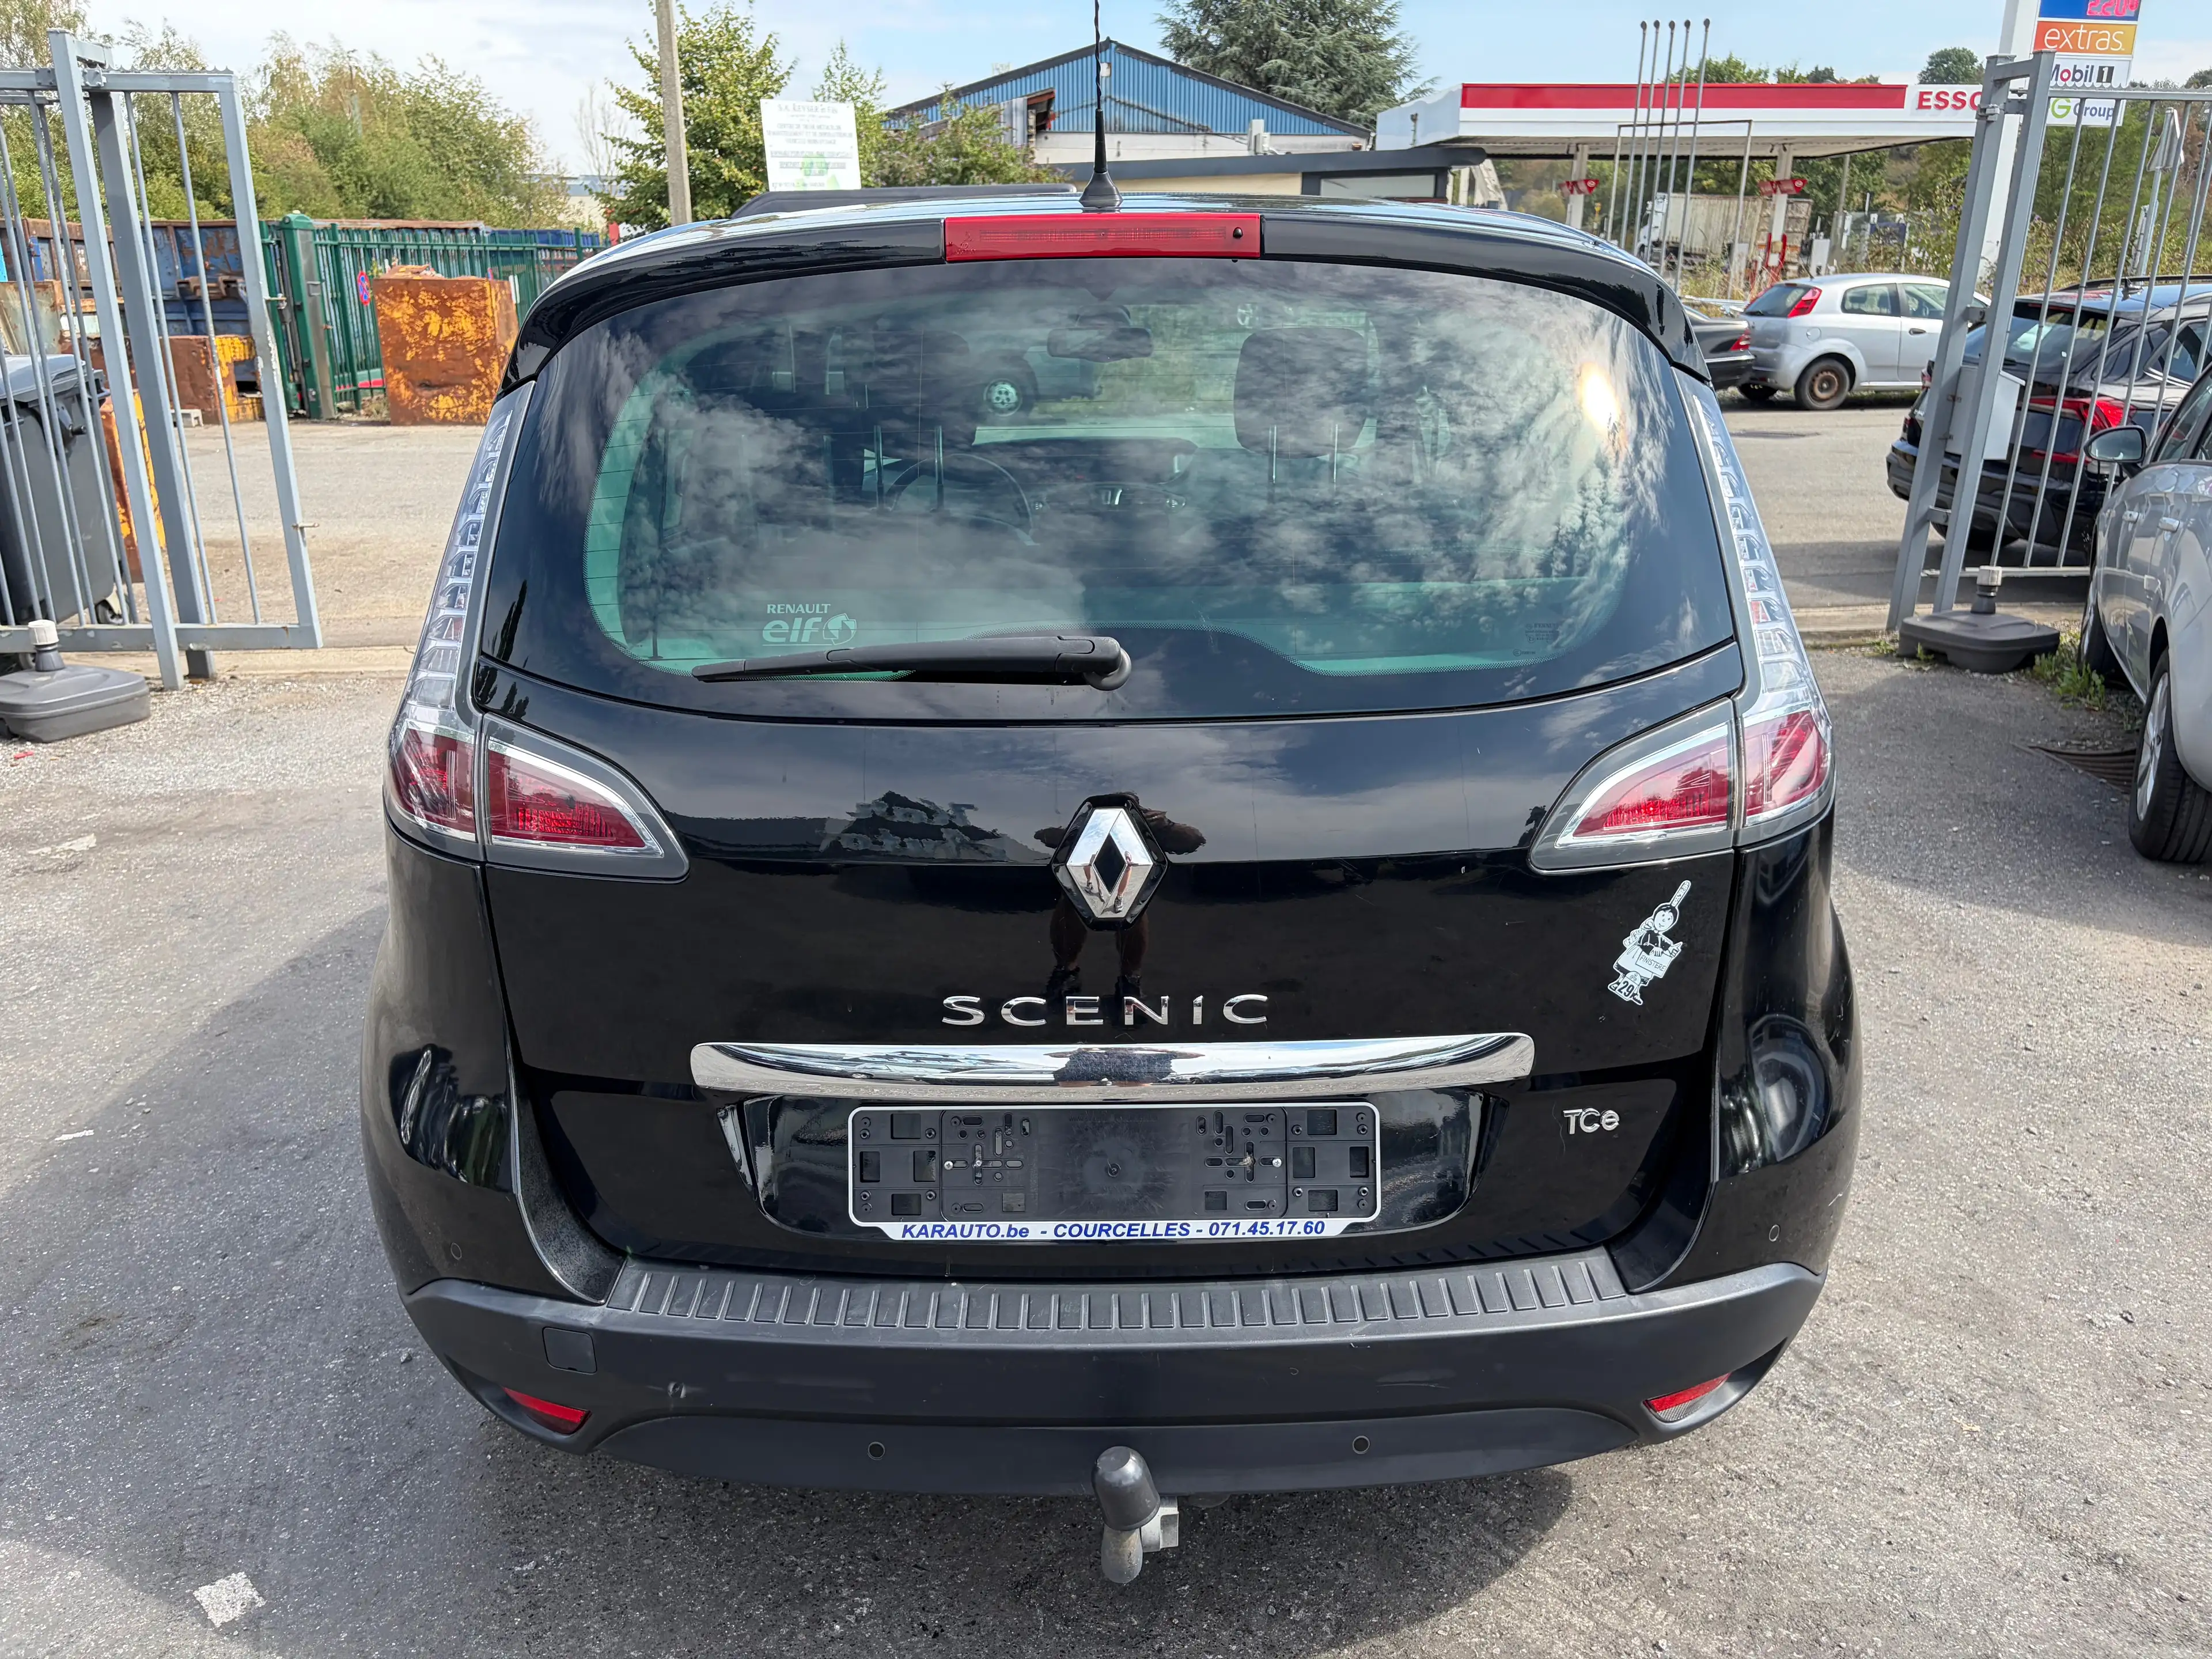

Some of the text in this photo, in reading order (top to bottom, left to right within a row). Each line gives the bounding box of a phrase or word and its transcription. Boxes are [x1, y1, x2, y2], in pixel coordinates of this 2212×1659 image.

[2044, 24, 2124, 51] extras
[767, 604, 831, 614] RENAULT
[762, 617, 822, 643] elf
[1639, 955, 1666, 971] FINISTERE
[1618, 980, 1635, 997] 29
[942, 994, 1268, 1027] SCENIC
[1563, 1108, 1620, 1134] TCe
[901, 1224, 1029, 1238] KARAUTO.be
[1053, 1222, 1191, 1238] COURCELLES
[1209, 1221, 1325, 1236] 071.45.17.60
